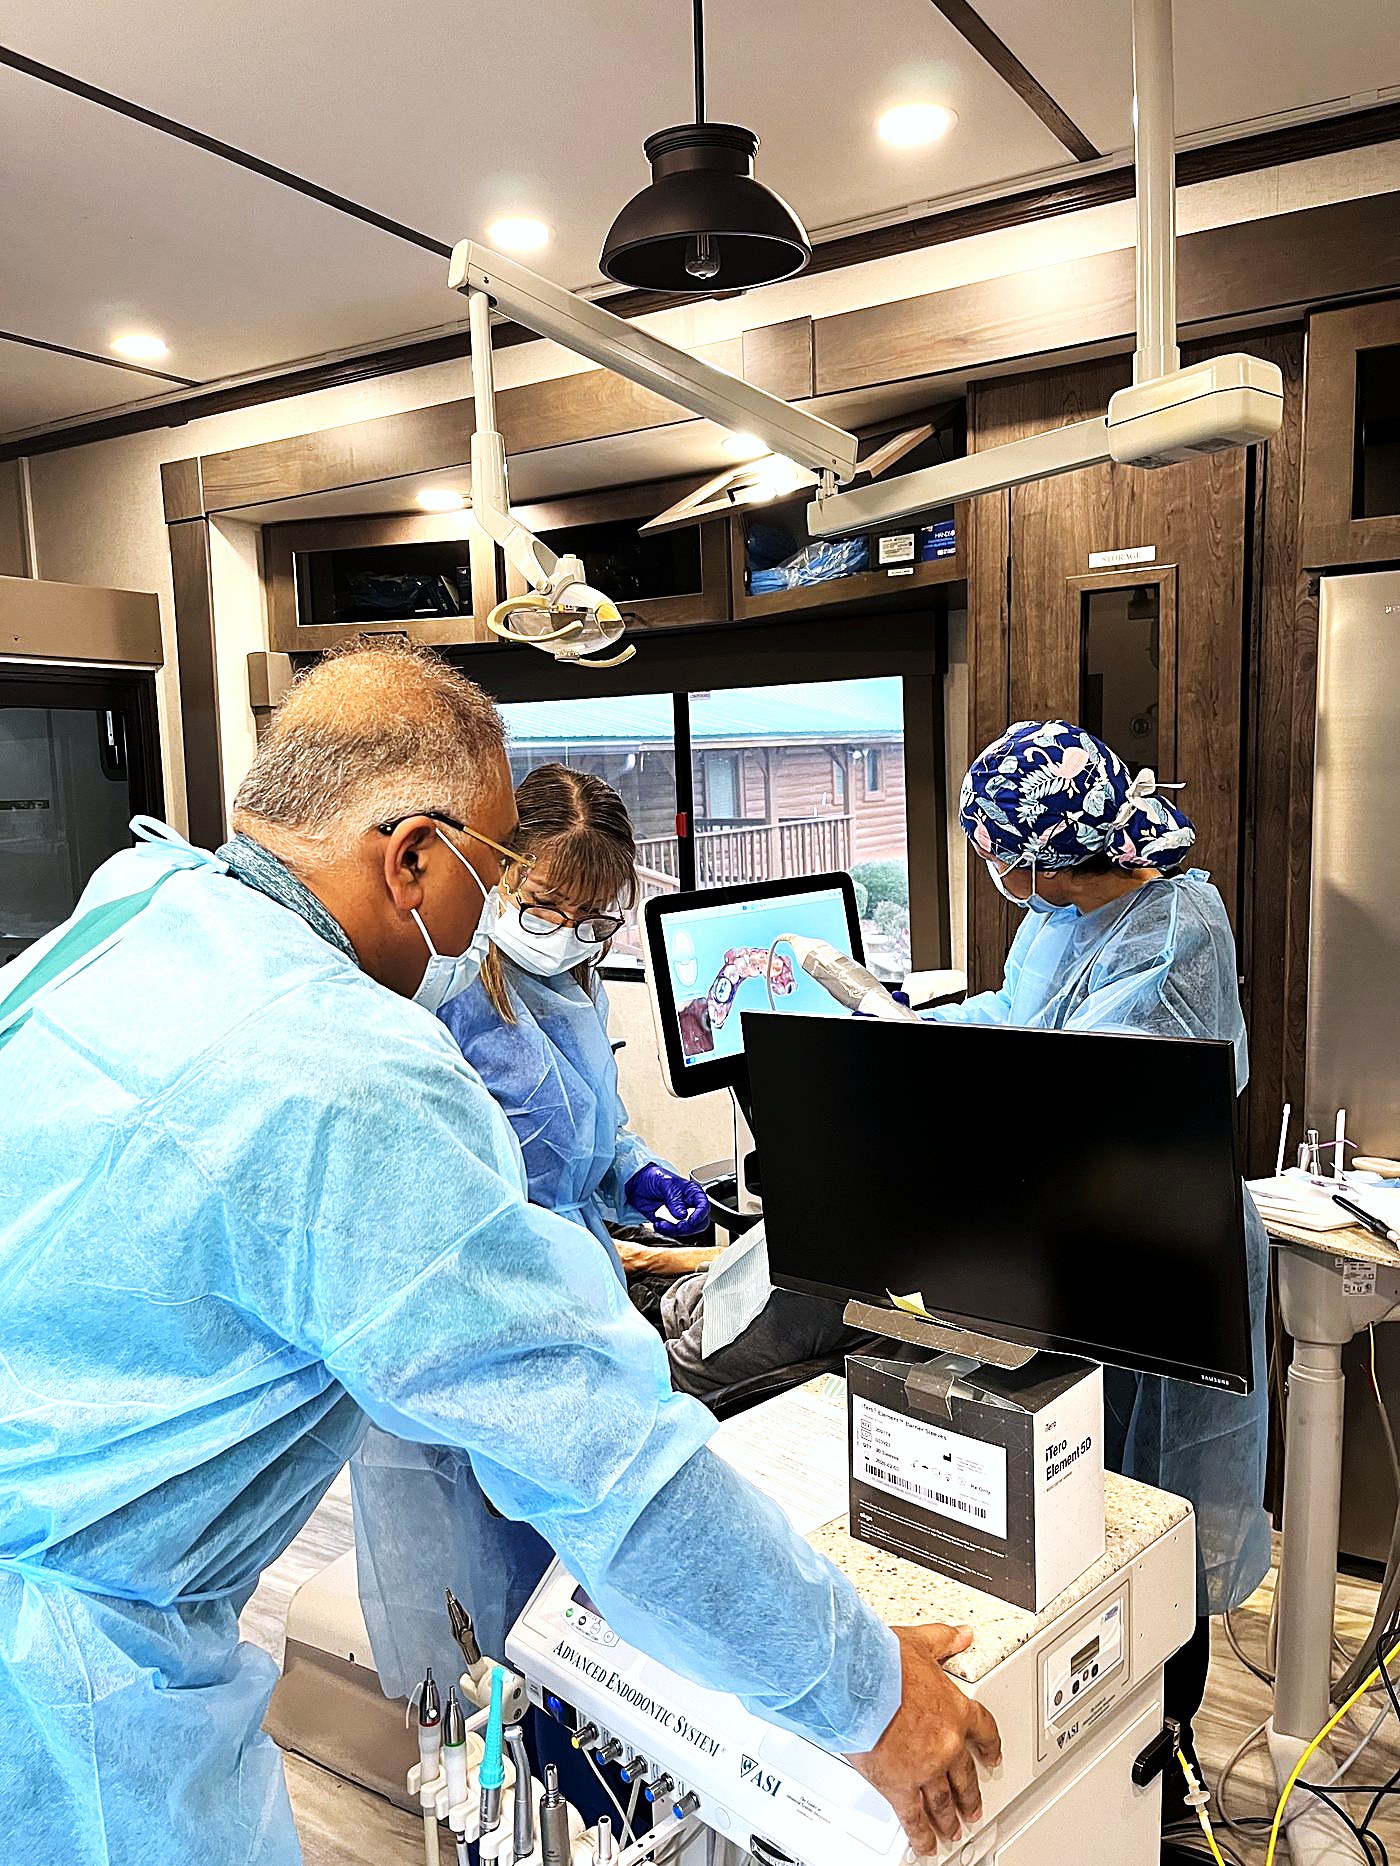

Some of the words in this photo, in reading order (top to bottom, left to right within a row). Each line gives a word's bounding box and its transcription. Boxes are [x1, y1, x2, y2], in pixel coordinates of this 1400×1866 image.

[1201, 1375, 1229, 1386] SAMSUNG
[1045, 1440, 1067, 1462] iTero
[1046, 1445, 1080, 1481] Element
[1080, 1436, 1092, 1455] 5D
[553, 1640, 608, 1684] ADVANCED
[604, 1671, 675, 1729] ENDODONTIC
[673, 1715, 721, 1758] SYSTEM
[751, 1770, 782, 1797] ASI
